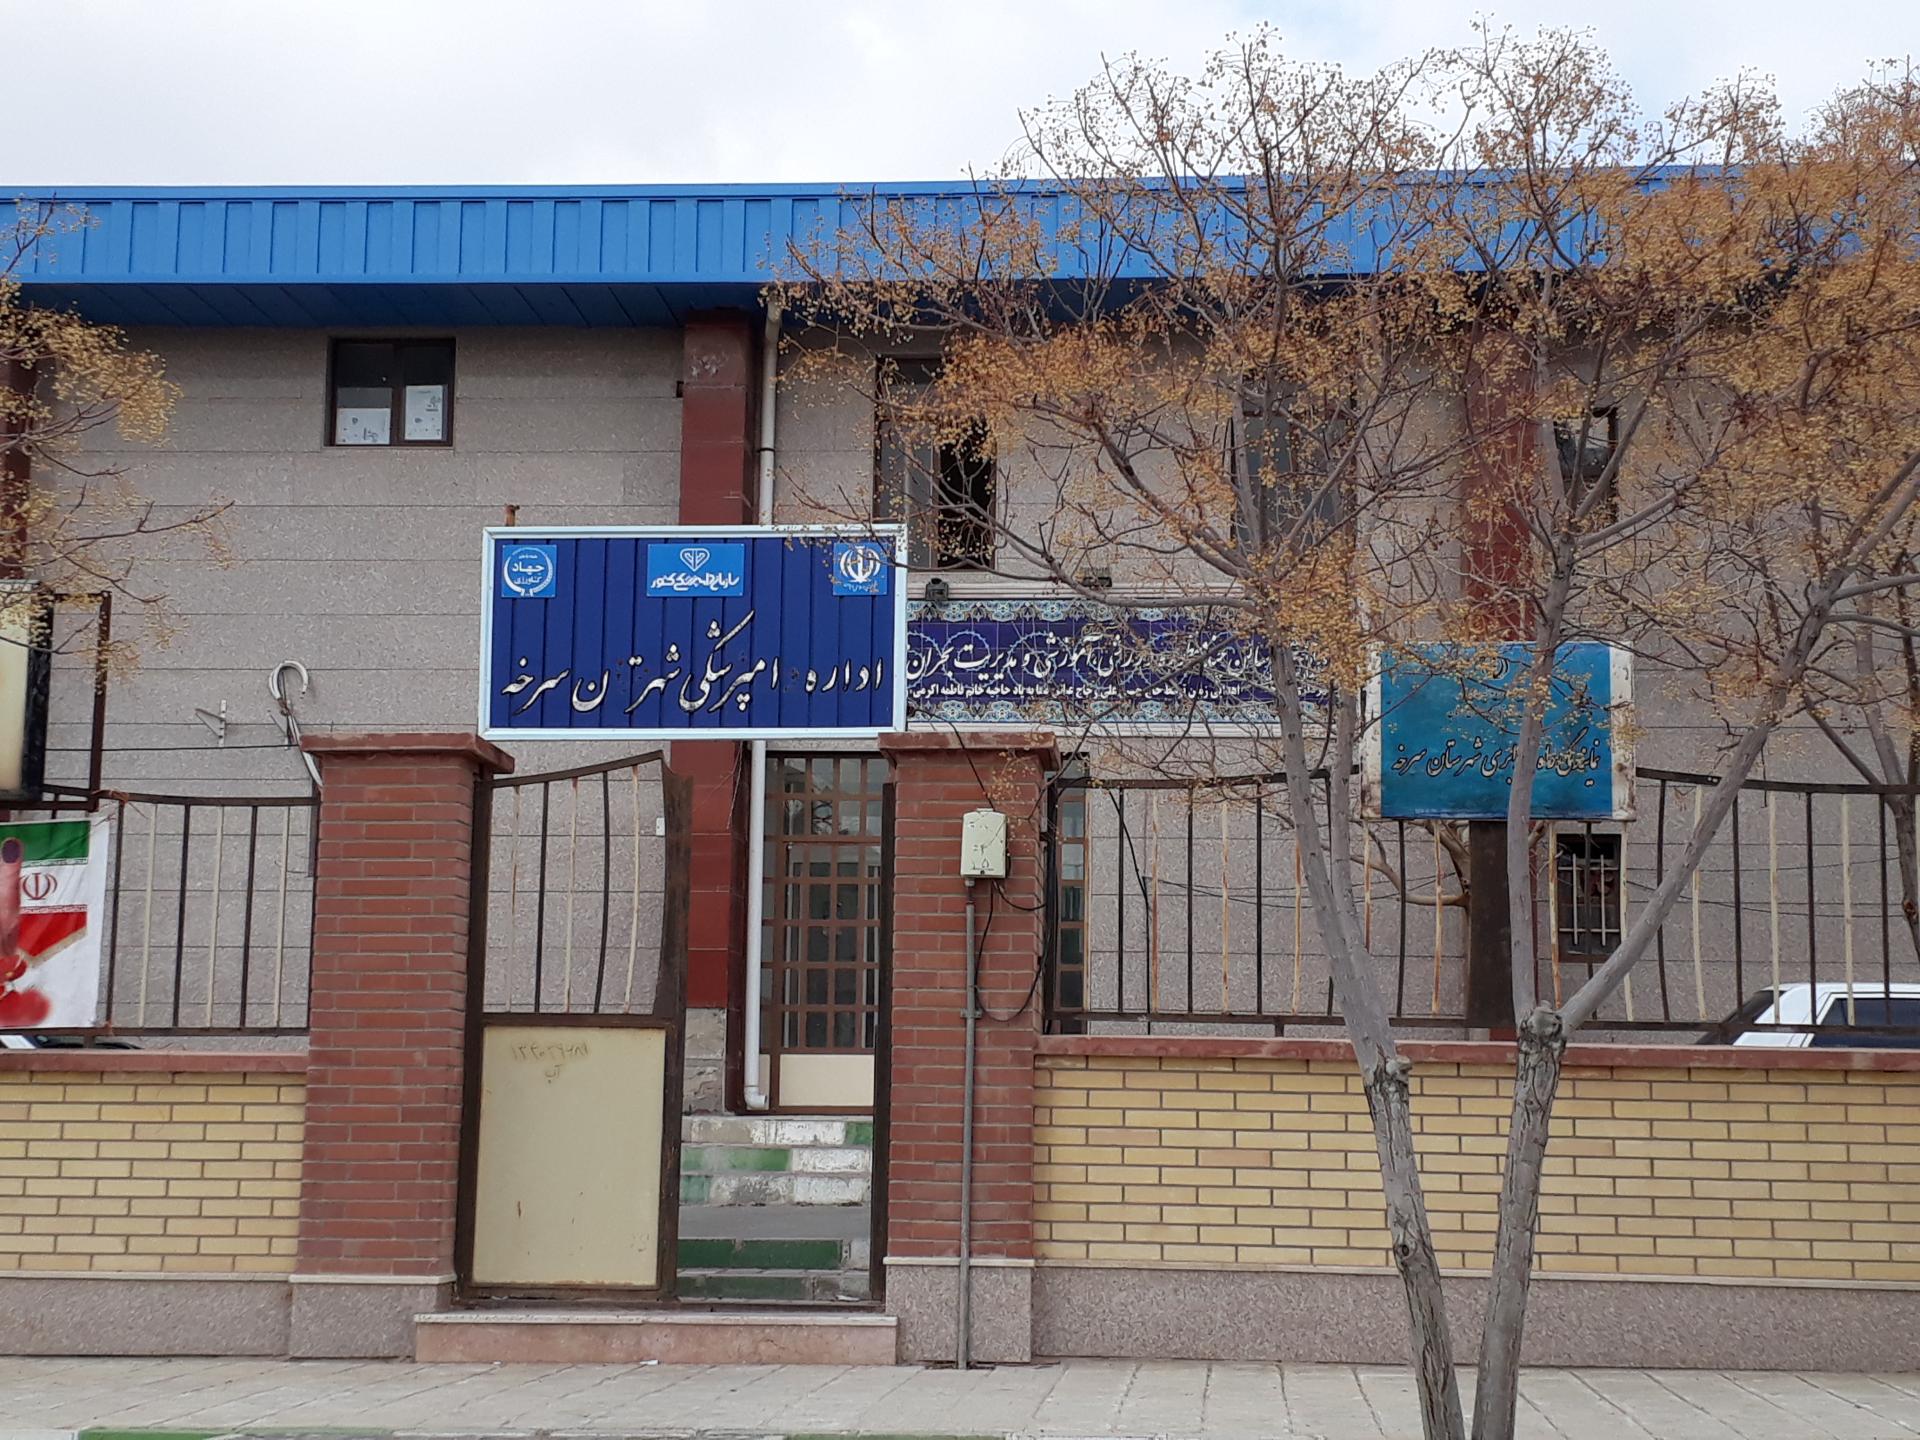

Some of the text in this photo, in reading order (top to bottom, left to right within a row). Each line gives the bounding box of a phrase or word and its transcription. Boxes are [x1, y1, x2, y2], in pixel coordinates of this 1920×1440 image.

[512, 561, 545, 575] جهاد
[805, 656, 884, 694] اداره
[906, 646, 955, 680] بحران
[953, 644, 1018, 681] مدیریت
[500, 657, 570, 716] سرخه
[1391, 745, 1428, 776] سرخه
[1427, 736, 1482, 776] شهرستان
